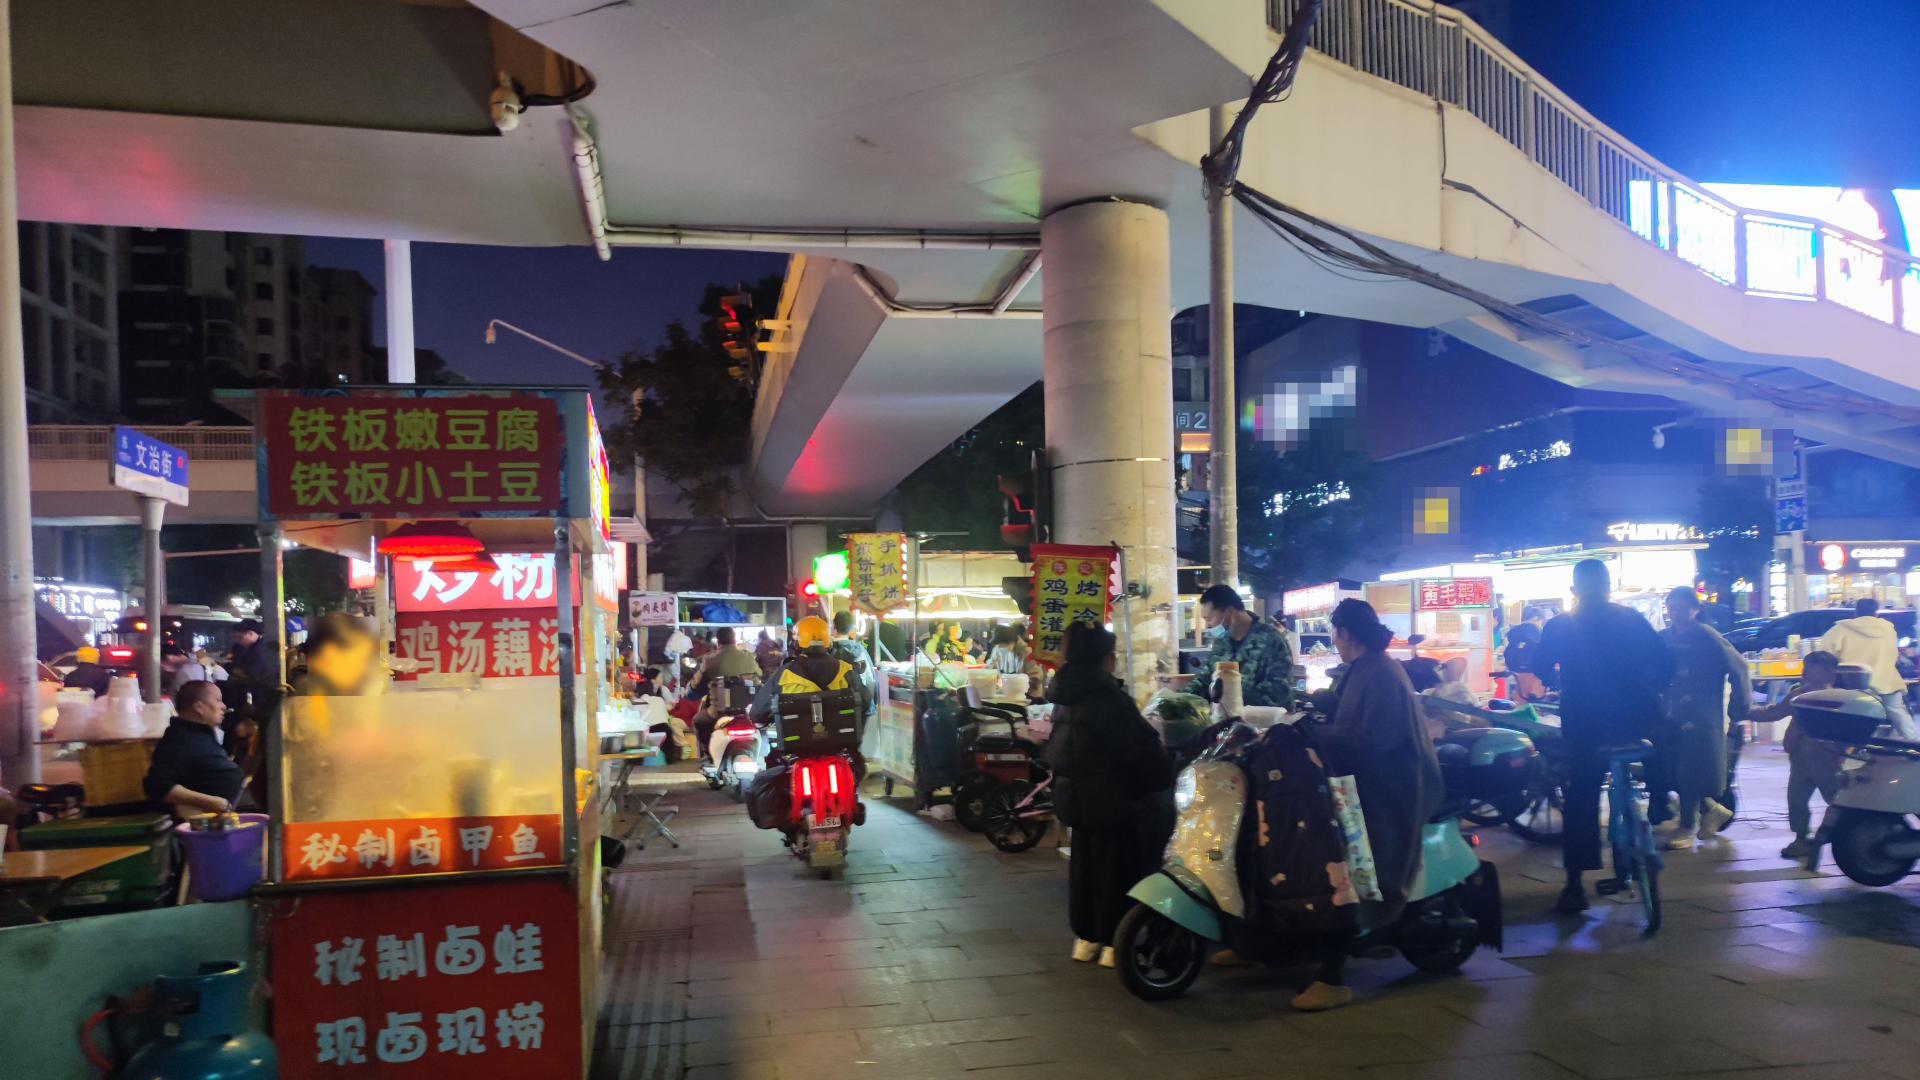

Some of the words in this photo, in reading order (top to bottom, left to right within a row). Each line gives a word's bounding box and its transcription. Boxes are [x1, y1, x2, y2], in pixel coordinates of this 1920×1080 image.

[288, 407, 540, 452] 铁板嫩豆腐
[135, 440, 173, 477] 文治街
[290, 461, 543, 506] 铁板小土豆
[879, 539, 900, 600] 手抓饼
[300, 823, 546, 871] 秘制卤甲鱼
[313, 922, 545, 986] 秘制卤蛙
[314, 1000, 546, 1066] 现卤现捞
